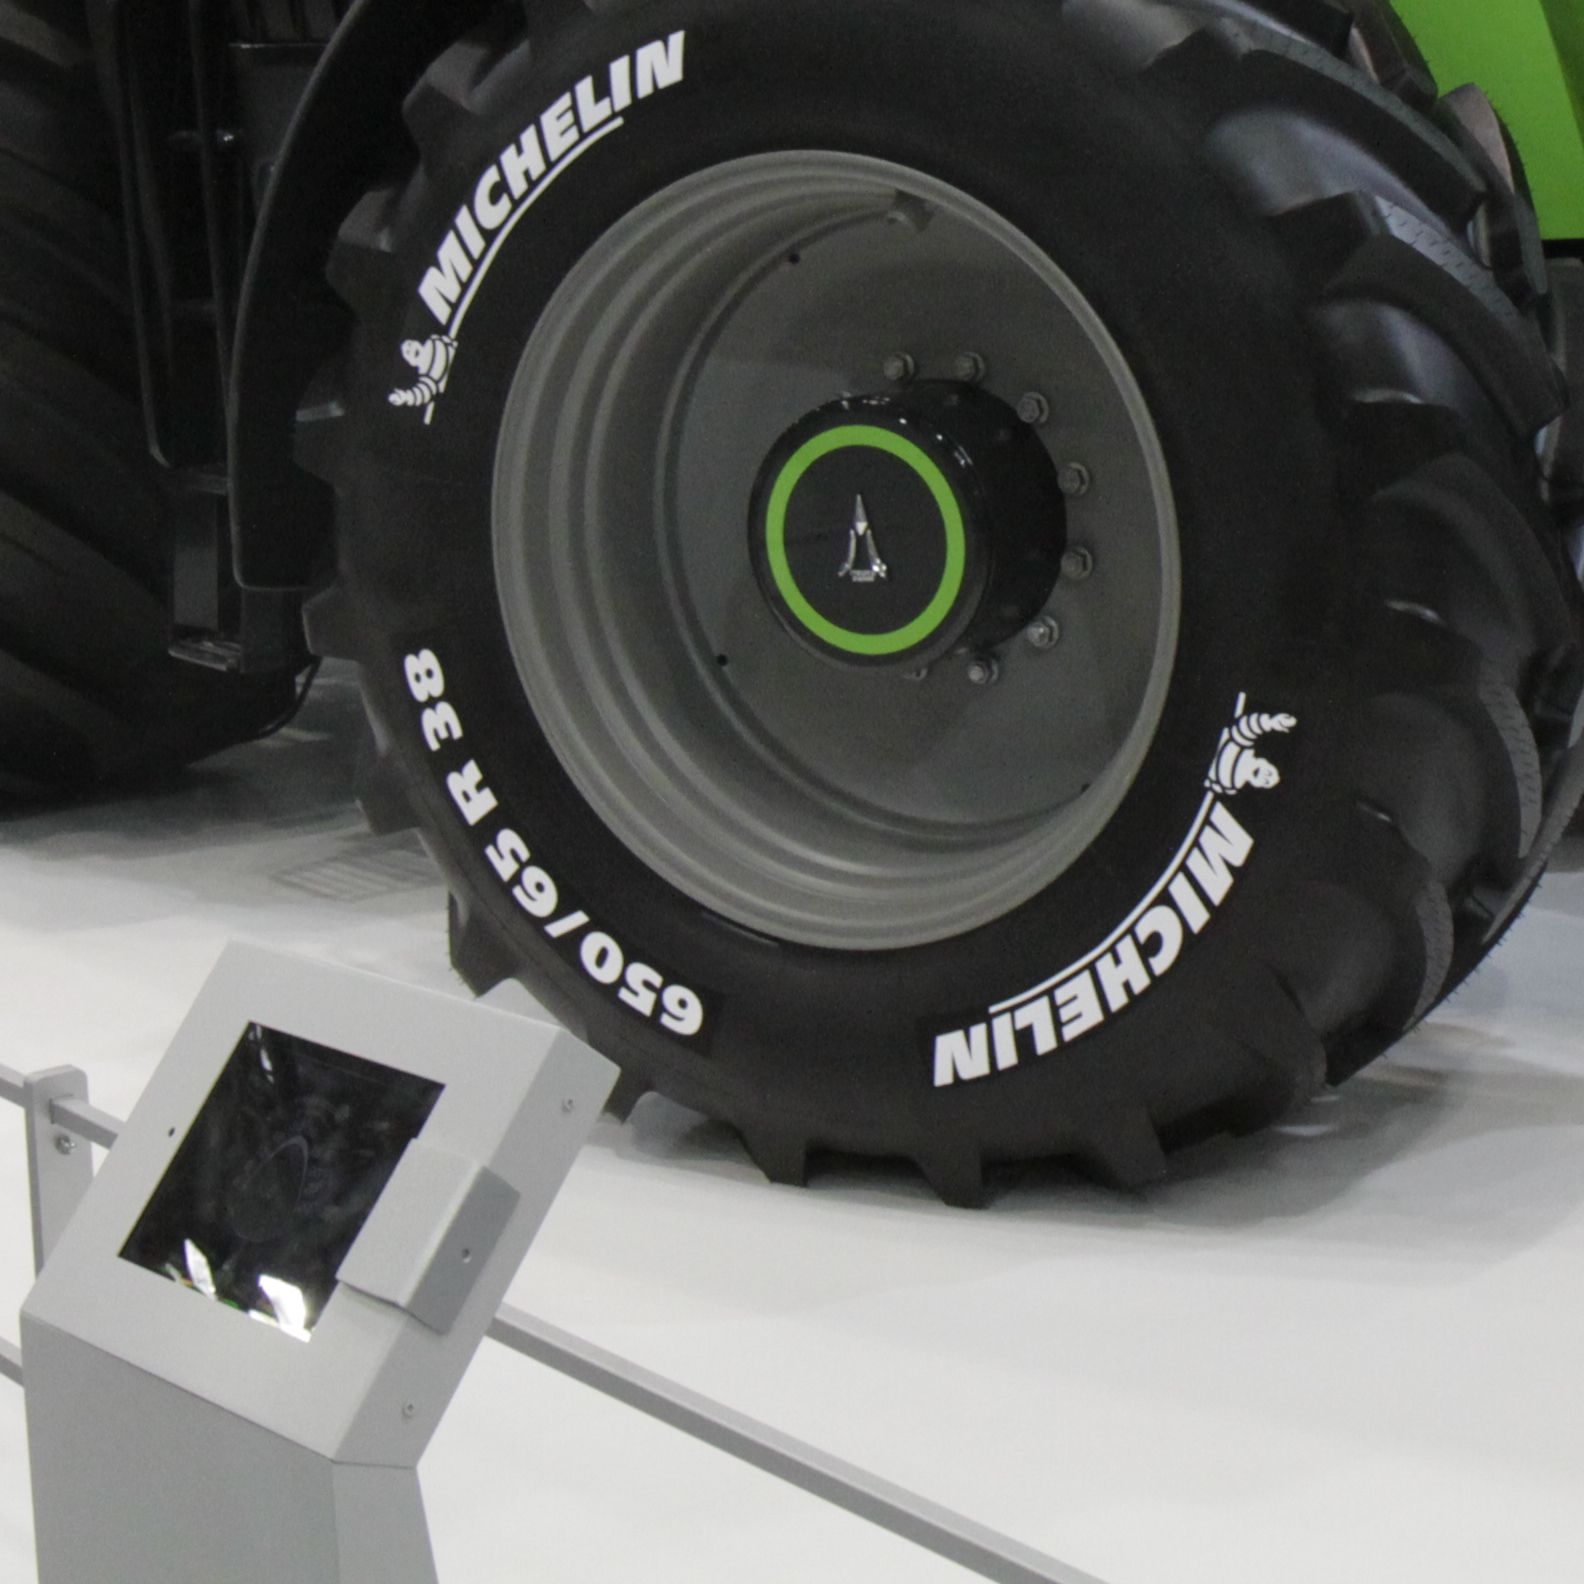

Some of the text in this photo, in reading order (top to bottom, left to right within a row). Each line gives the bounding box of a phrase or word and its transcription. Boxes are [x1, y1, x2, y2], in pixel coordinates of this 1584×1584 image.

[419, 30, 685, 325] MICHELIN
[405, 649, 703, 1035] 650/65 R 38
[934, 802, 1254, 1087] MICHELIN
